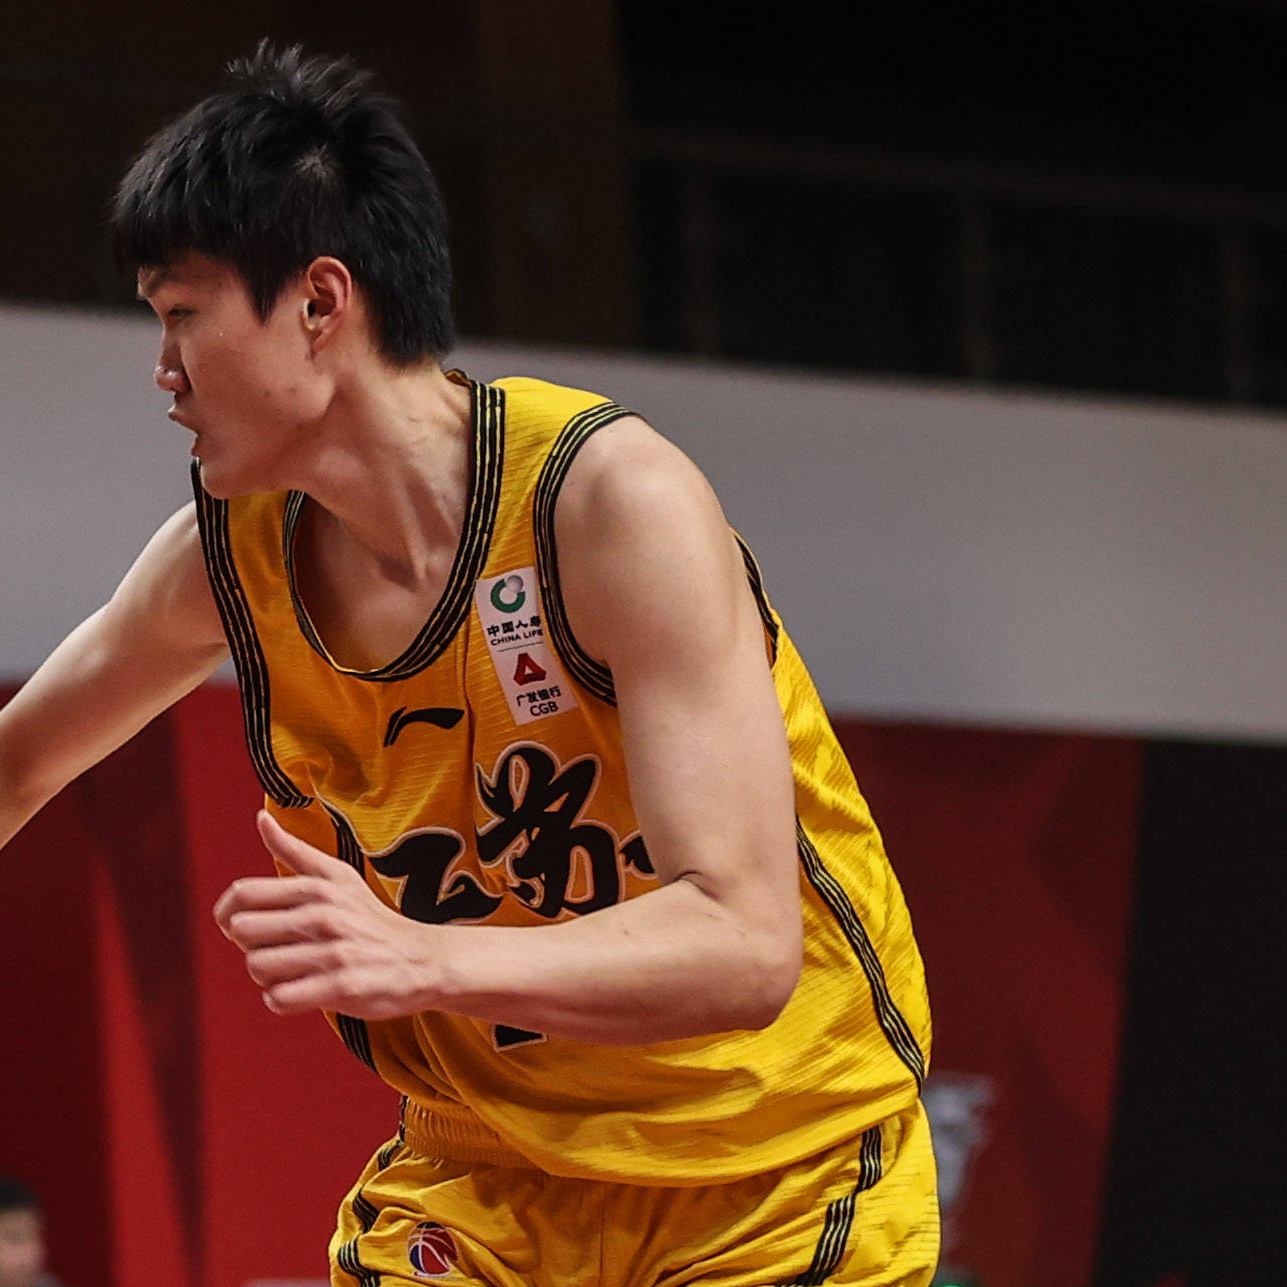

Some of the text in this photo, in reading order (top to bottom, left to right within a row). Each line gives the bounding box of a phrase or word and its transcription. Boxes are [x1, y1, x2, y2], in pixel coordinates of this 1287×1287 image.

[486, 615, 542, 637] 中国人寿
[490, 628, 544, 646] CHINA LIFE
[515, 685, 562, 707] 广发银行
[529, 700, 559, 717] CGB
